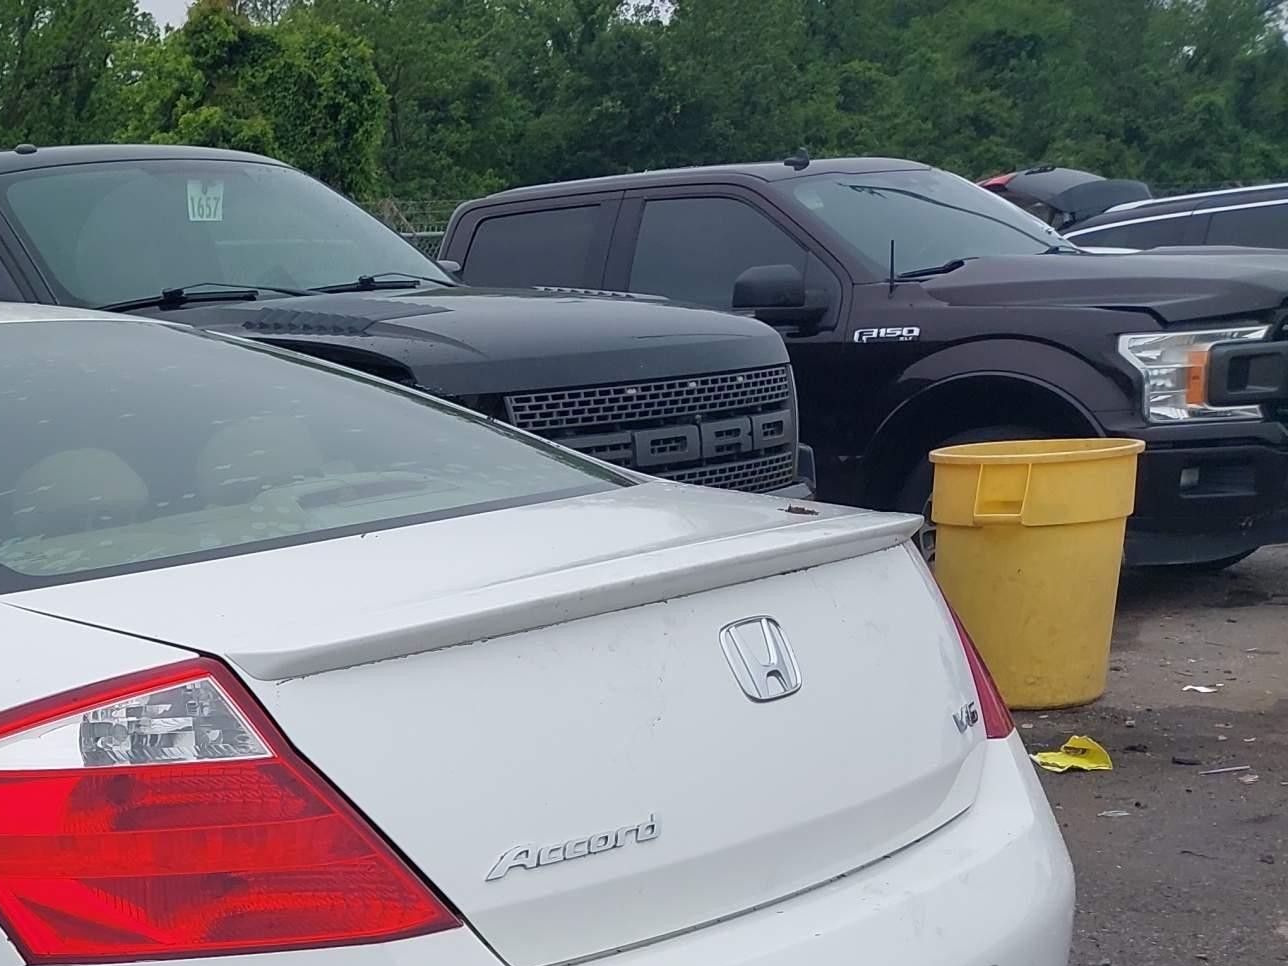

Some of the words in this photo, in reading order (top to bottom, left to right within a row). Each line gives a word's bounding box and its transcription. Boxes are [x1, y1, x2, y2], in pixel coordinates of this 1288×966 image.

[190, 195, 221, 219] 1657
[952, 701, 979, 735] V6
[484, 812, 661, 882] Accord
